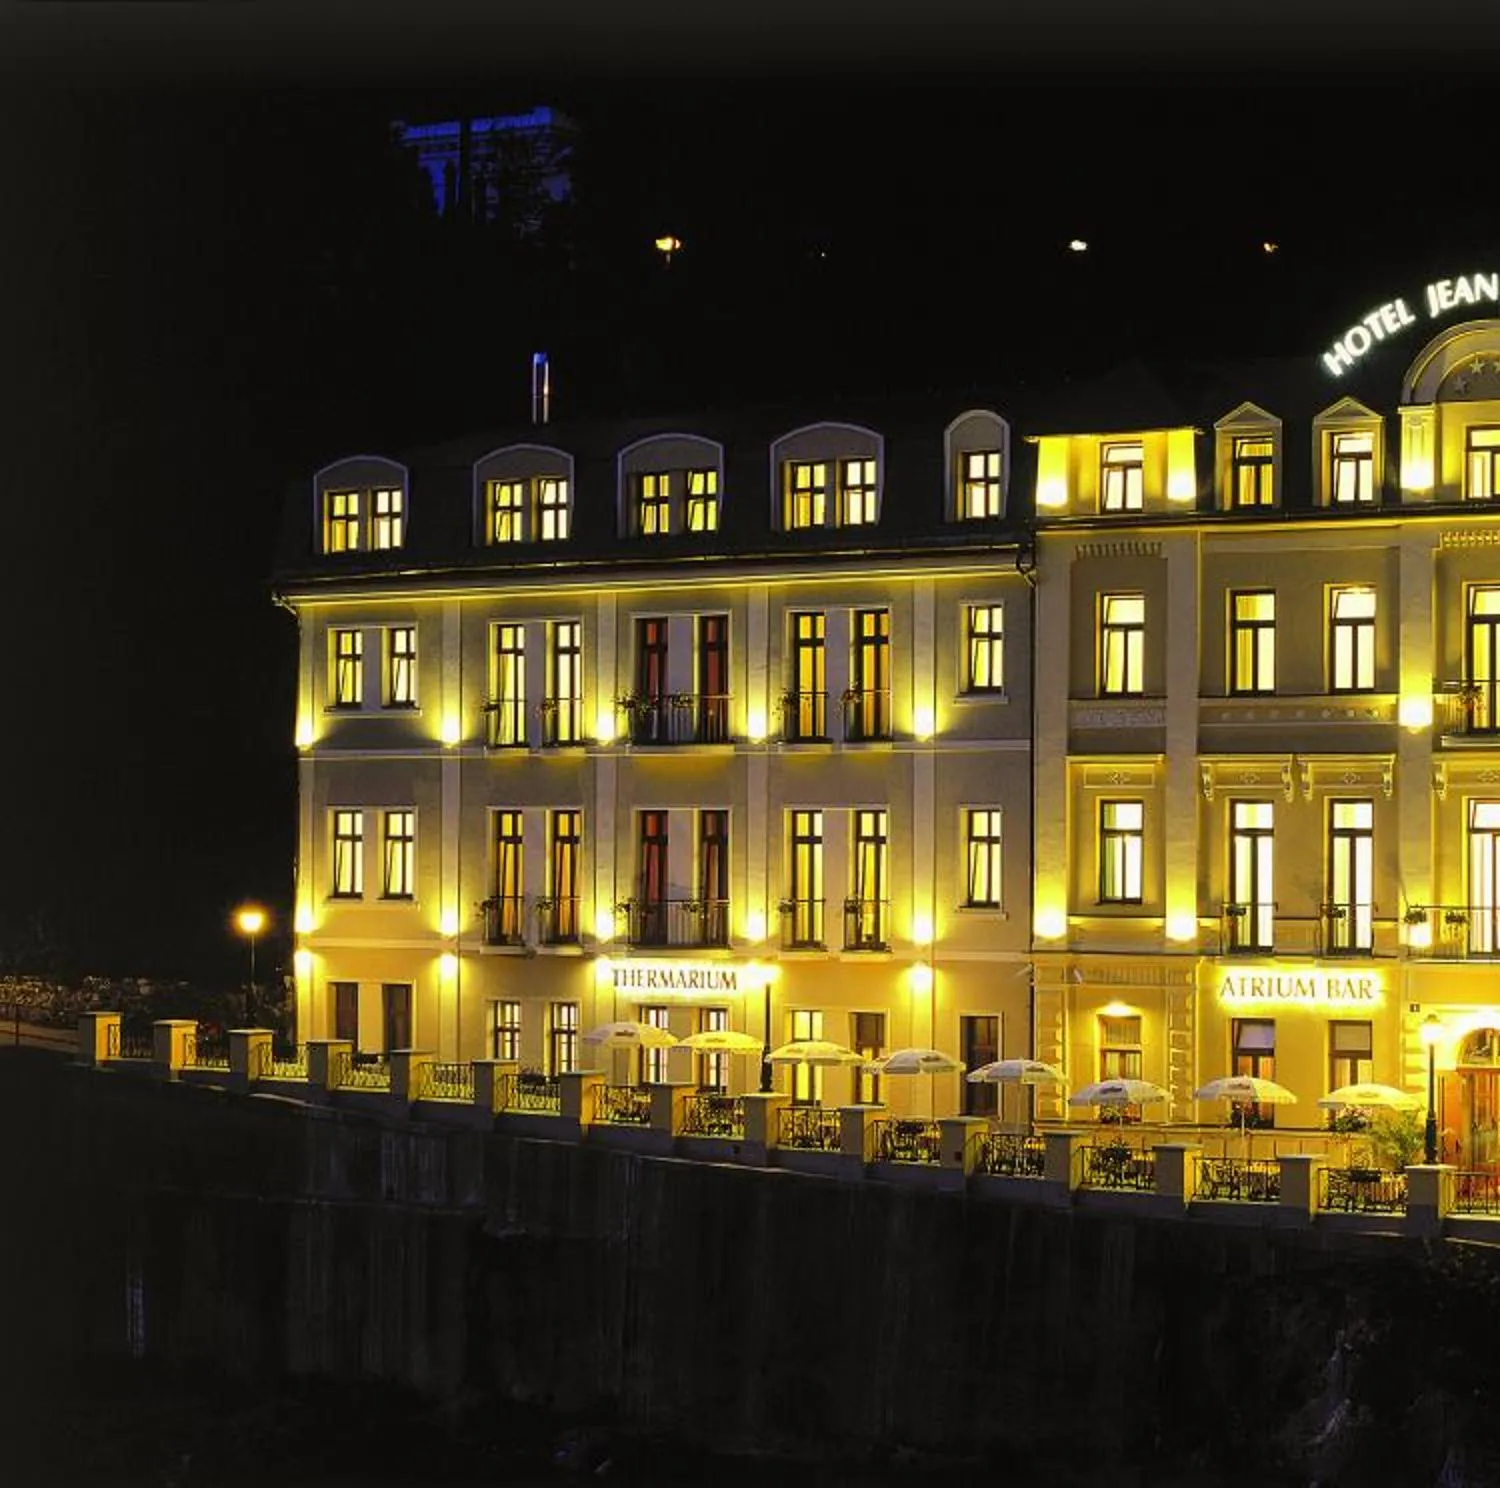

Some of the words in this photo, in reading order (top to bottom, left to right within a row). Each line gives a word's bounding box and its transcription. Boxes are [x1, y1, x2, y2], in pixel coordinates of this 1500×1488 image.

[1322, 298, 1417, 377] HOTEL
[1426, 272, 1499, 319] JEAN
[612, 968, 738, 991] THERMARIUM
[1219, 976, 1316, 999] ATRIUM
[1326, 978, 1374, 1000] BAR
